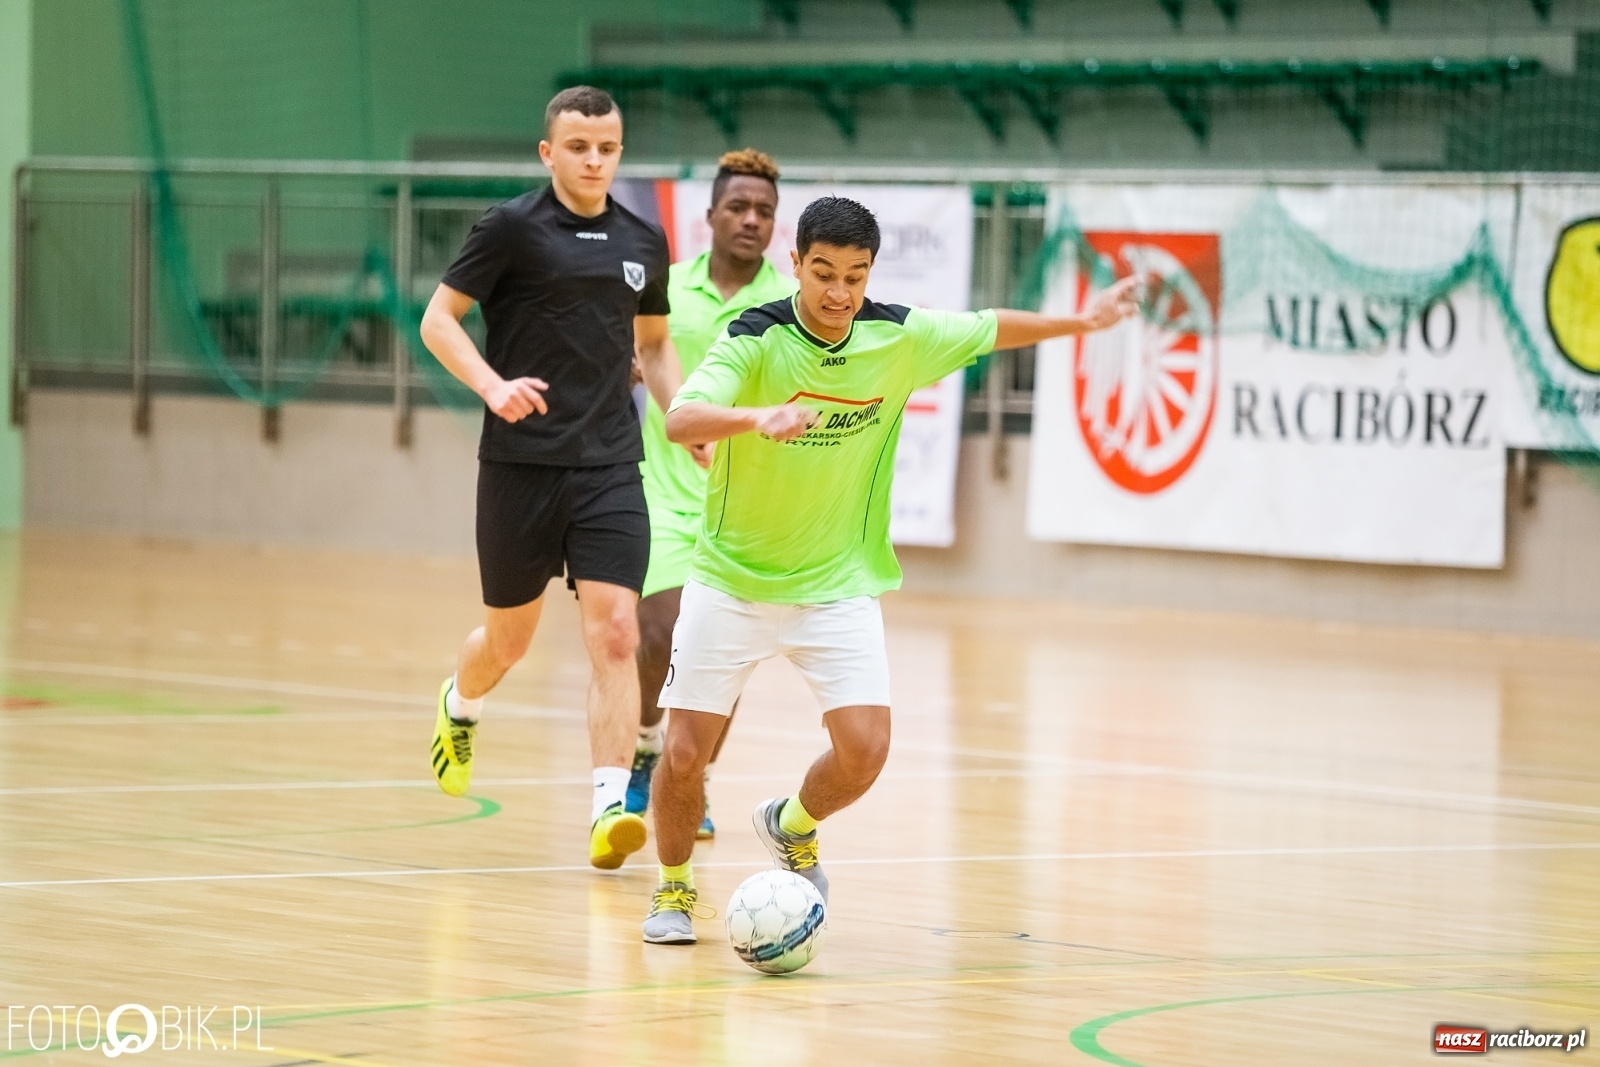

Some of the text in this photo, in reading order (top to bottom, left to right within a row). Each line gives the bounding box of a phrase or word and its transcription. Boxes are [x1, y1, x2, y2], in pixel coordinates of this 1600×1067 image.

[1263, 294, 1457, 357] MIASTO
[820, 356, 847, 368] JAKO
[1233, 368, 1492, 450] RACIBÓRZ
